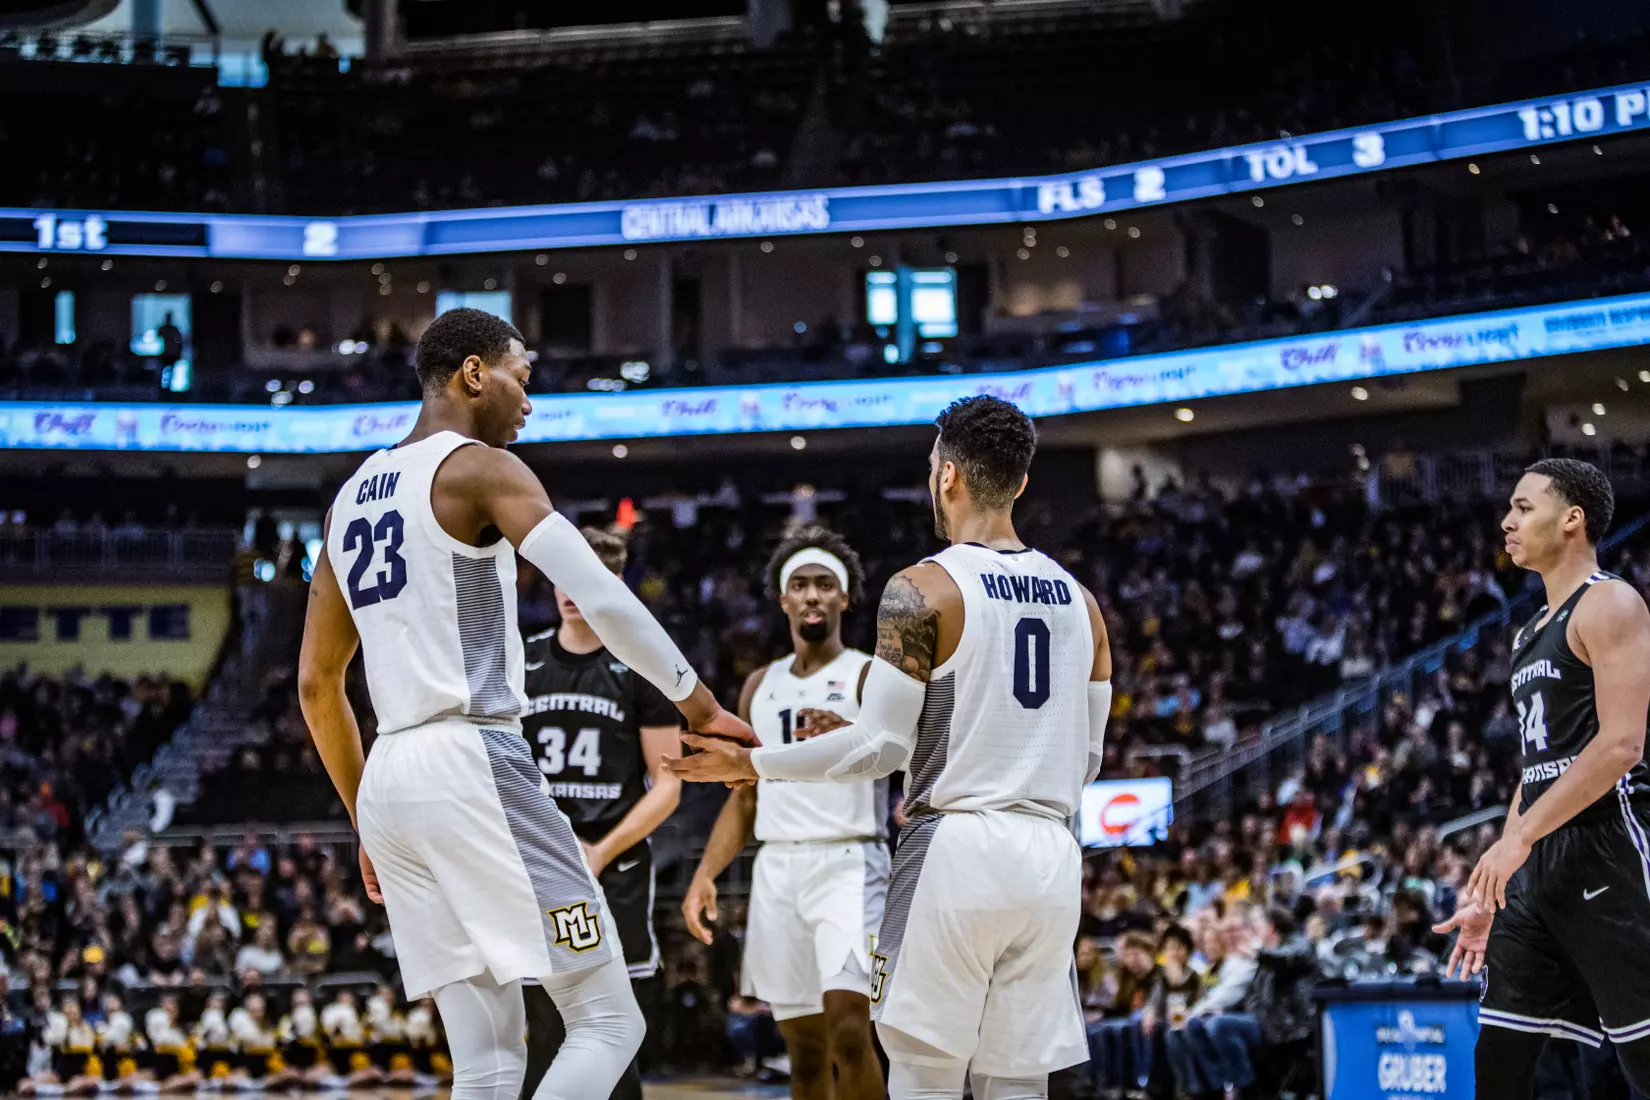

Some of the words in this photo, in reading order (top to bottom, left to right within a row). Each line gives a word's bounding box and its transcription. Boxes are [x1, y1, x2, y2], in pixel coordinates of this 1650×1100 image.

[1517, 97, 1604, 141] 1:10
[1615, 87, 1650, 127] P
[1245, 145, 1318, 182] TOL
[1352, 132, 1386, 168] 3
[1037, 176, 1105, 214] FLS
[1134, 166, 1166, 202] 2
[33, 213, 107, 250] 1st
[303, 221, 339, 256] 2
[622, 200, 710, 240] CENTRAL
[712, 193, 830, 236] ARKANSAS
[356, 471, 401, 505] CAIN
[343, 509, 407, 610] 23
[980, 573, 1072, 605] HOWARD
[1013, 617, 1050, 709] 0
[1511, 659, 1562, 696] ENTRAL
[537, 727, 602, 776] 34
[546, 901, 601, 953] MU
[1378, 1052, 1447, 1093] GRUBER
